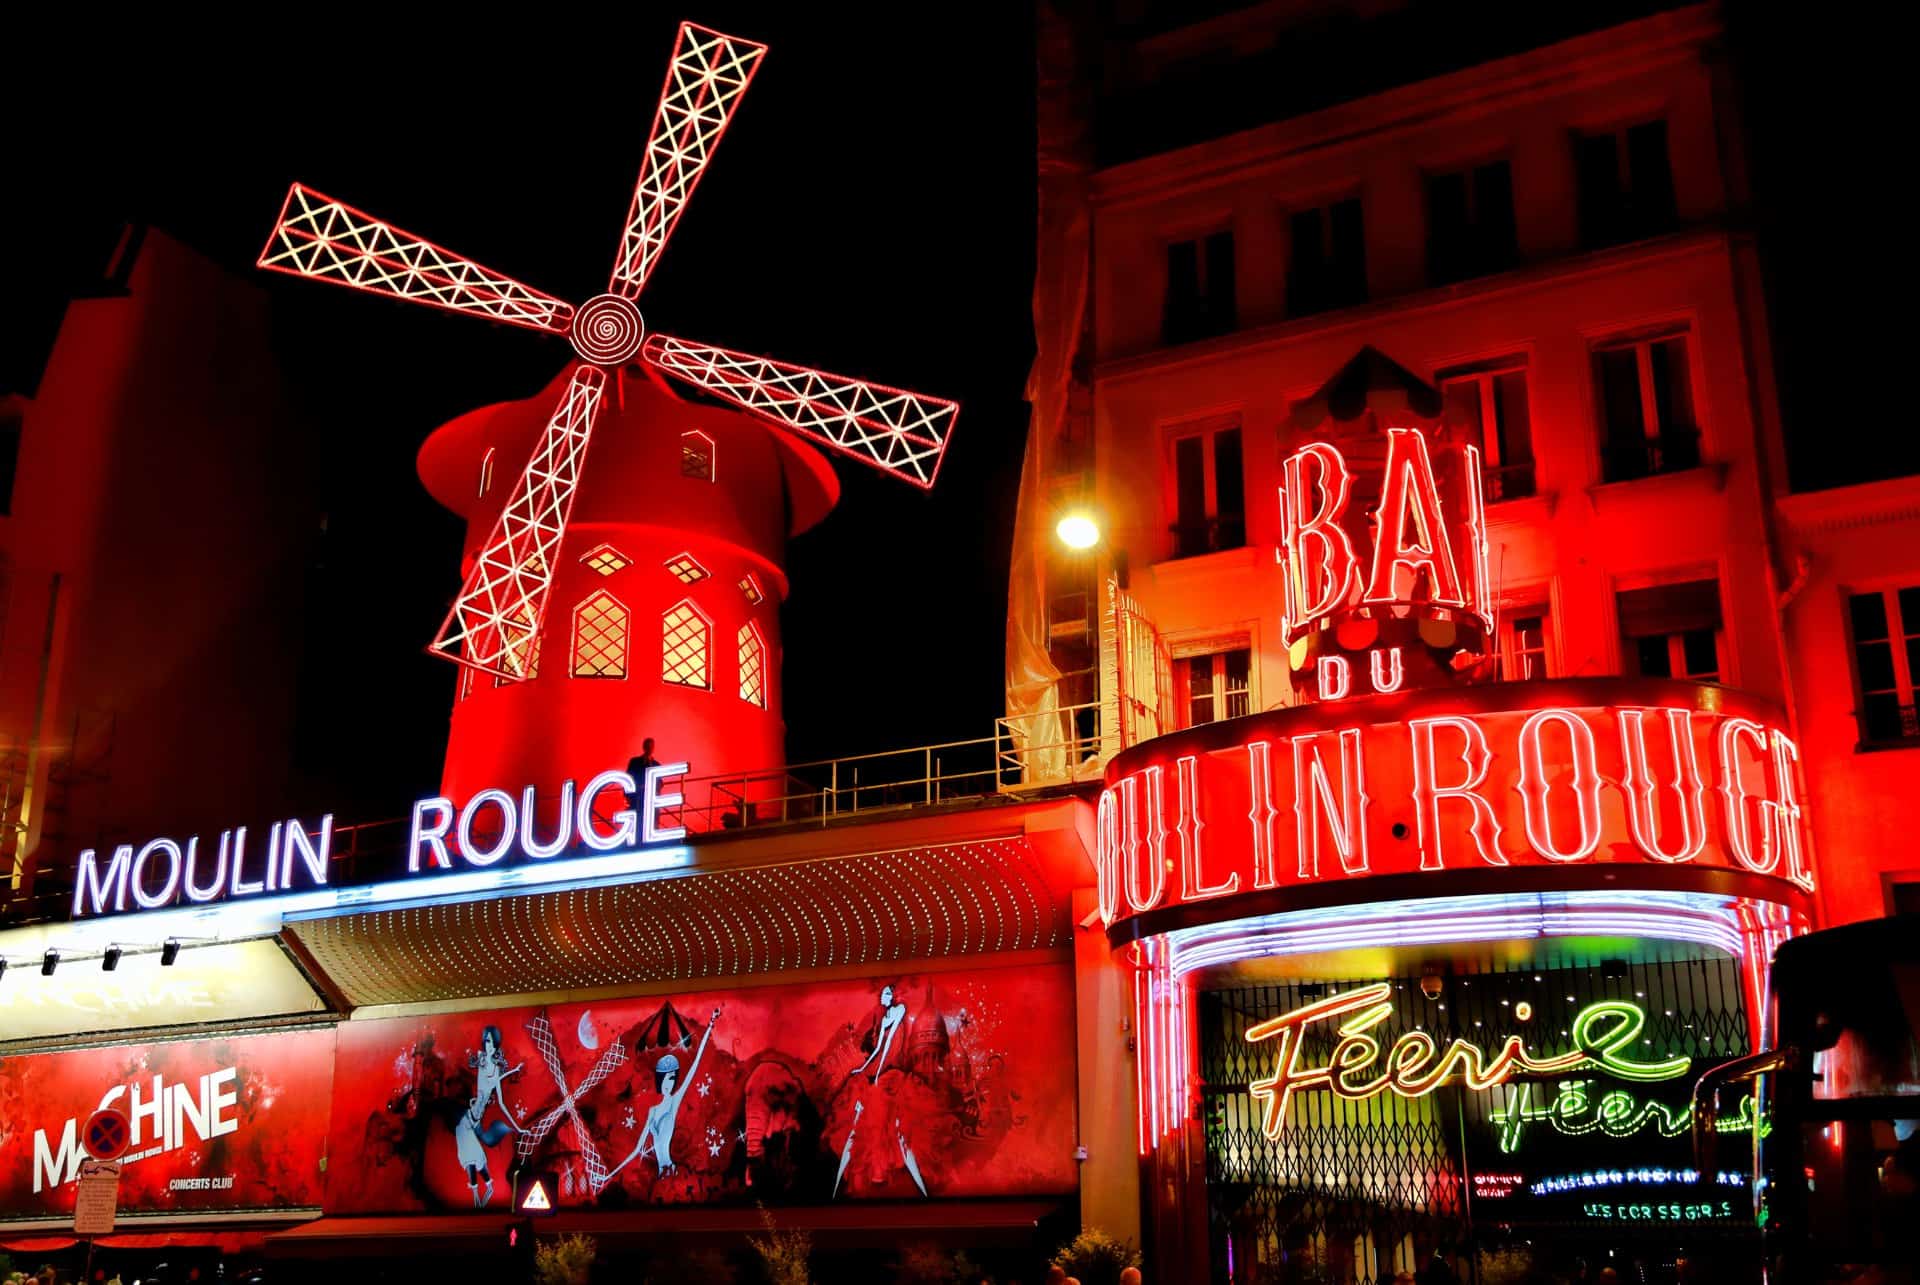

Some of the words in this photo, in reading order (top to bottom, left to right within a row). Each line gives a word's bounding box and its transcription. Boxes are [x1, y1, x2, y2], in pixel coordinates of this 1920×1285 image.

[1318, 648, 1402, 700] DU
[73, 813, 333, 917] MOULIN
[407, 763, 690, 873] ROUGE
[1408, 709, 1815, 892] ROUGE
[1245, 982, 1691, 1141] Féerie
[169, 1177, 211, 1191] CONCERTS
[211, 1176, 233, 1189] CLUB
